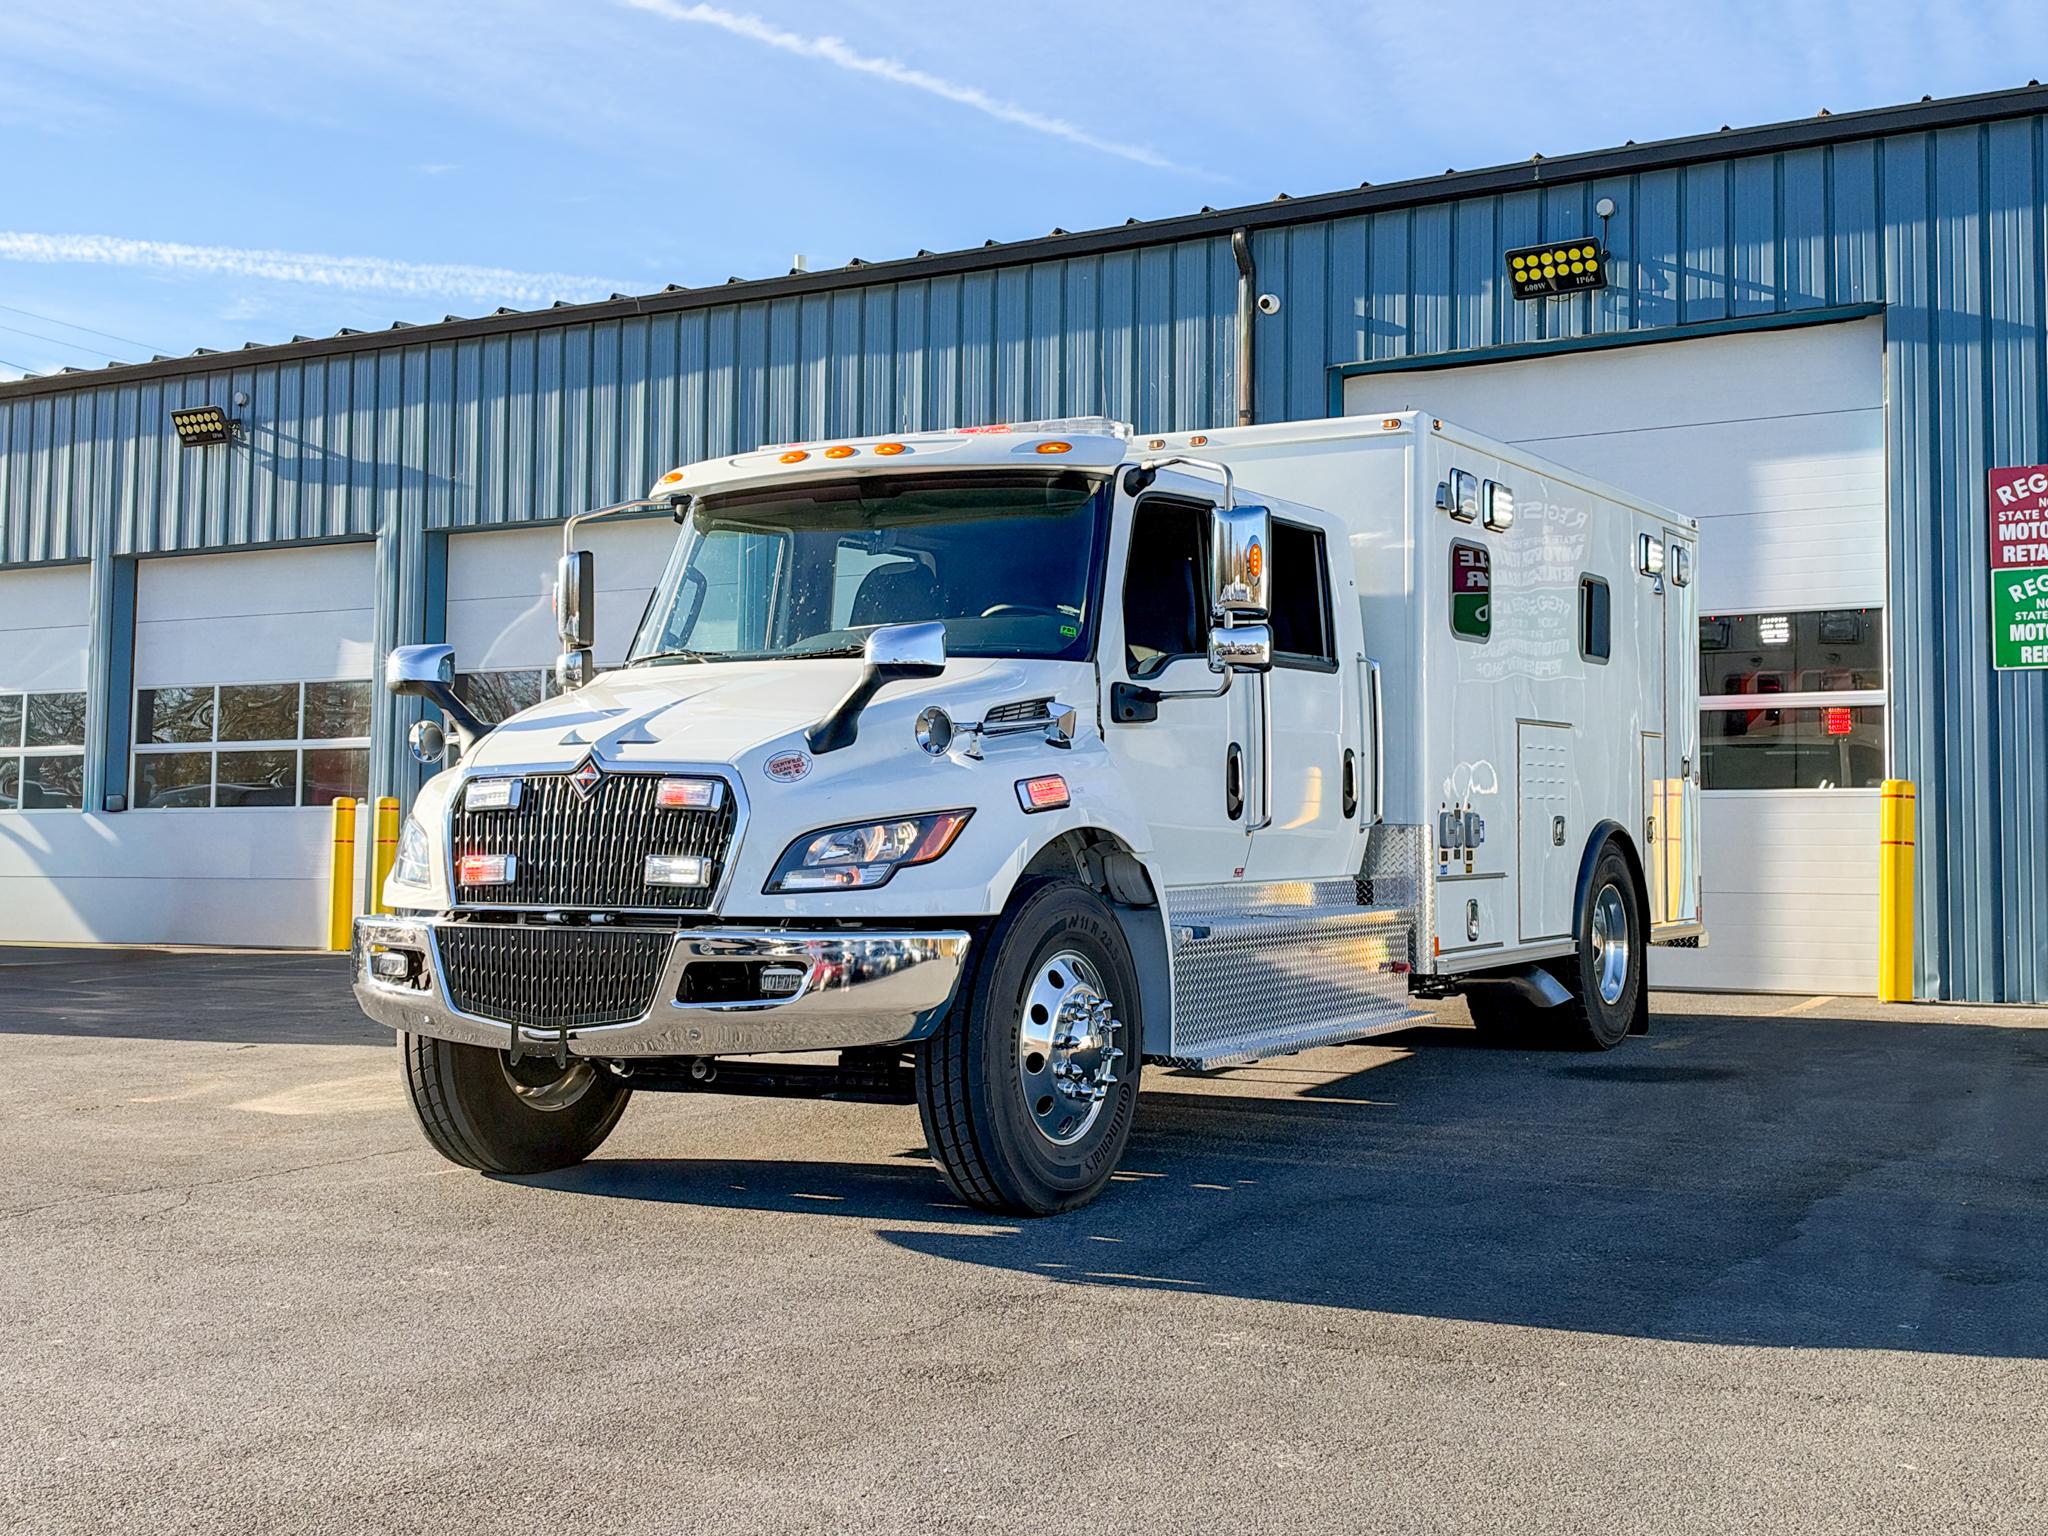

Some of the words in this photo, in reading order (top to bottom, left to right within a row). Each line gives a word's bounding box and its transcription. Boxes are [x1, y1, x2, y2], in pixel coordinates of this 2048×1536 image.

[1995, 473, 2048, 506] REG
[1998, 509, 2040, 522] STATE
[2003, 543, 2048, 563] RETA
[2008, 574, 2048, 603] REG
[2015, 610, 2048, 621] STATE
[2009, 622, 2048, 642] MOT
[772, 757, 802, 769] CERTIFIED
[772, 765, 792, 774] CLEAN
